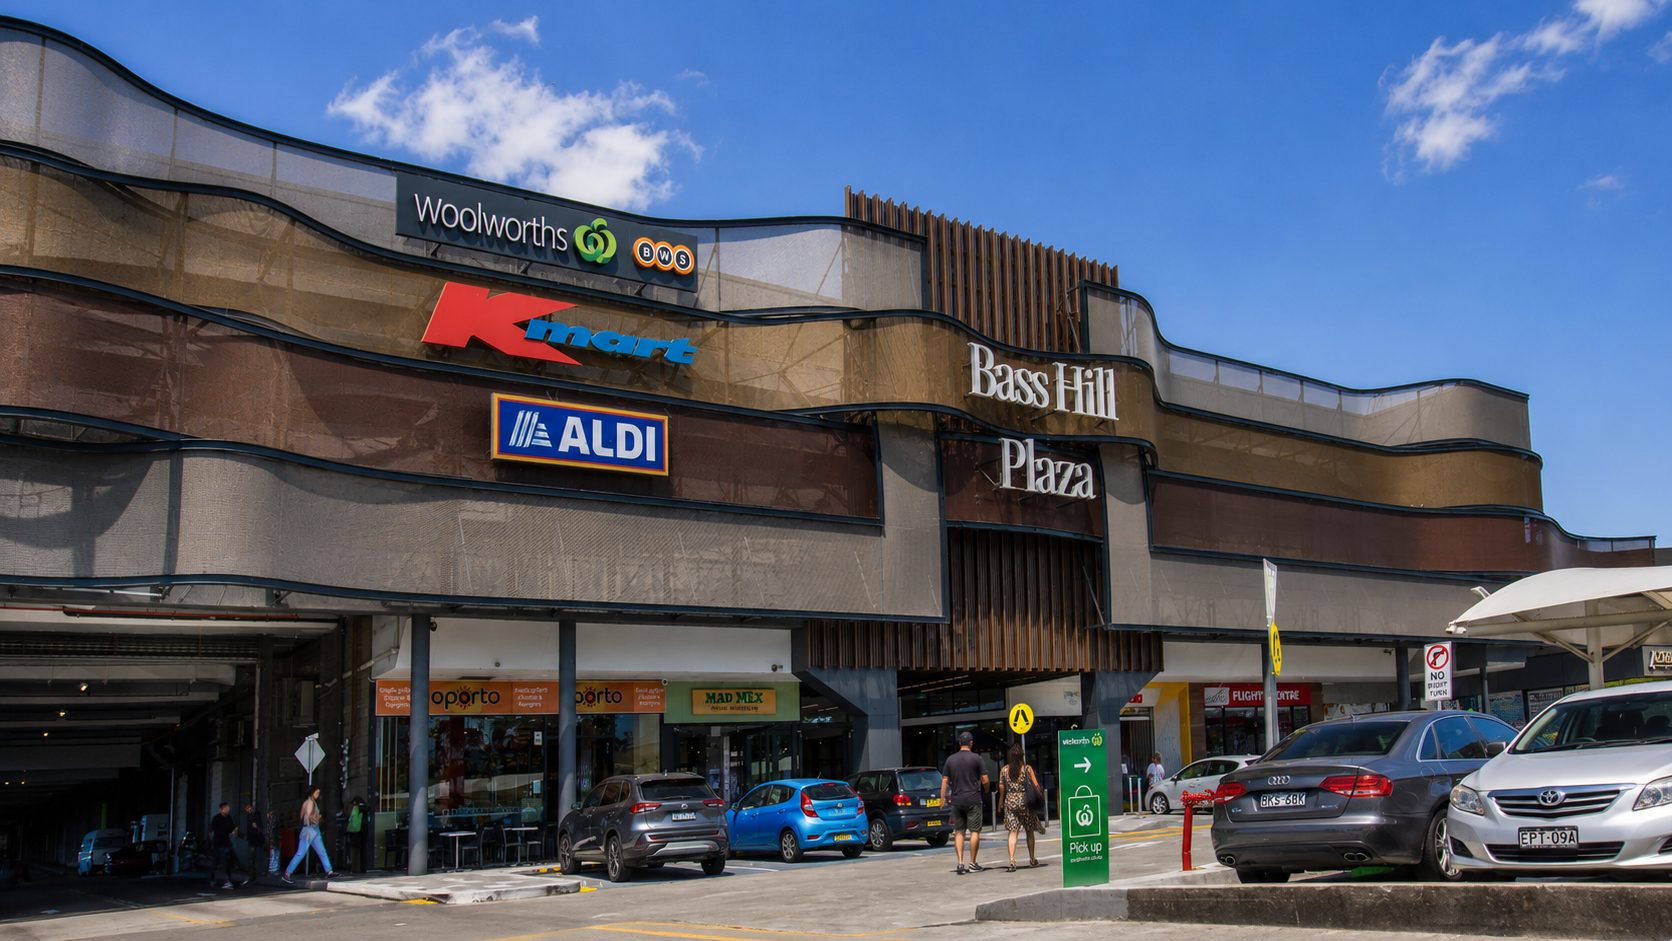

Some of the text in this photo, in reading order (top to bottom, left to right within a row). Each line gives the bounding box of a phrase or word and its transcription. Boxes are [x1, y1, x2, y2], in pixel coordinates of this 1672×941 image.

[414, 193, 568, 251] Woolworths
[421, 282, 698, 366] Kmart
[967, 342, 1119, 421] Bass Hill
[558, 415, 656, 462] ALDI
[1000, 437, 1096, 499] Plaza
[431, 687, 500, 709] oporto
[705, 691, 764, 704] MAD MEX
[1430, 671, 1445, 681] NO
[1069, 841, 1103, 854] Pick up
